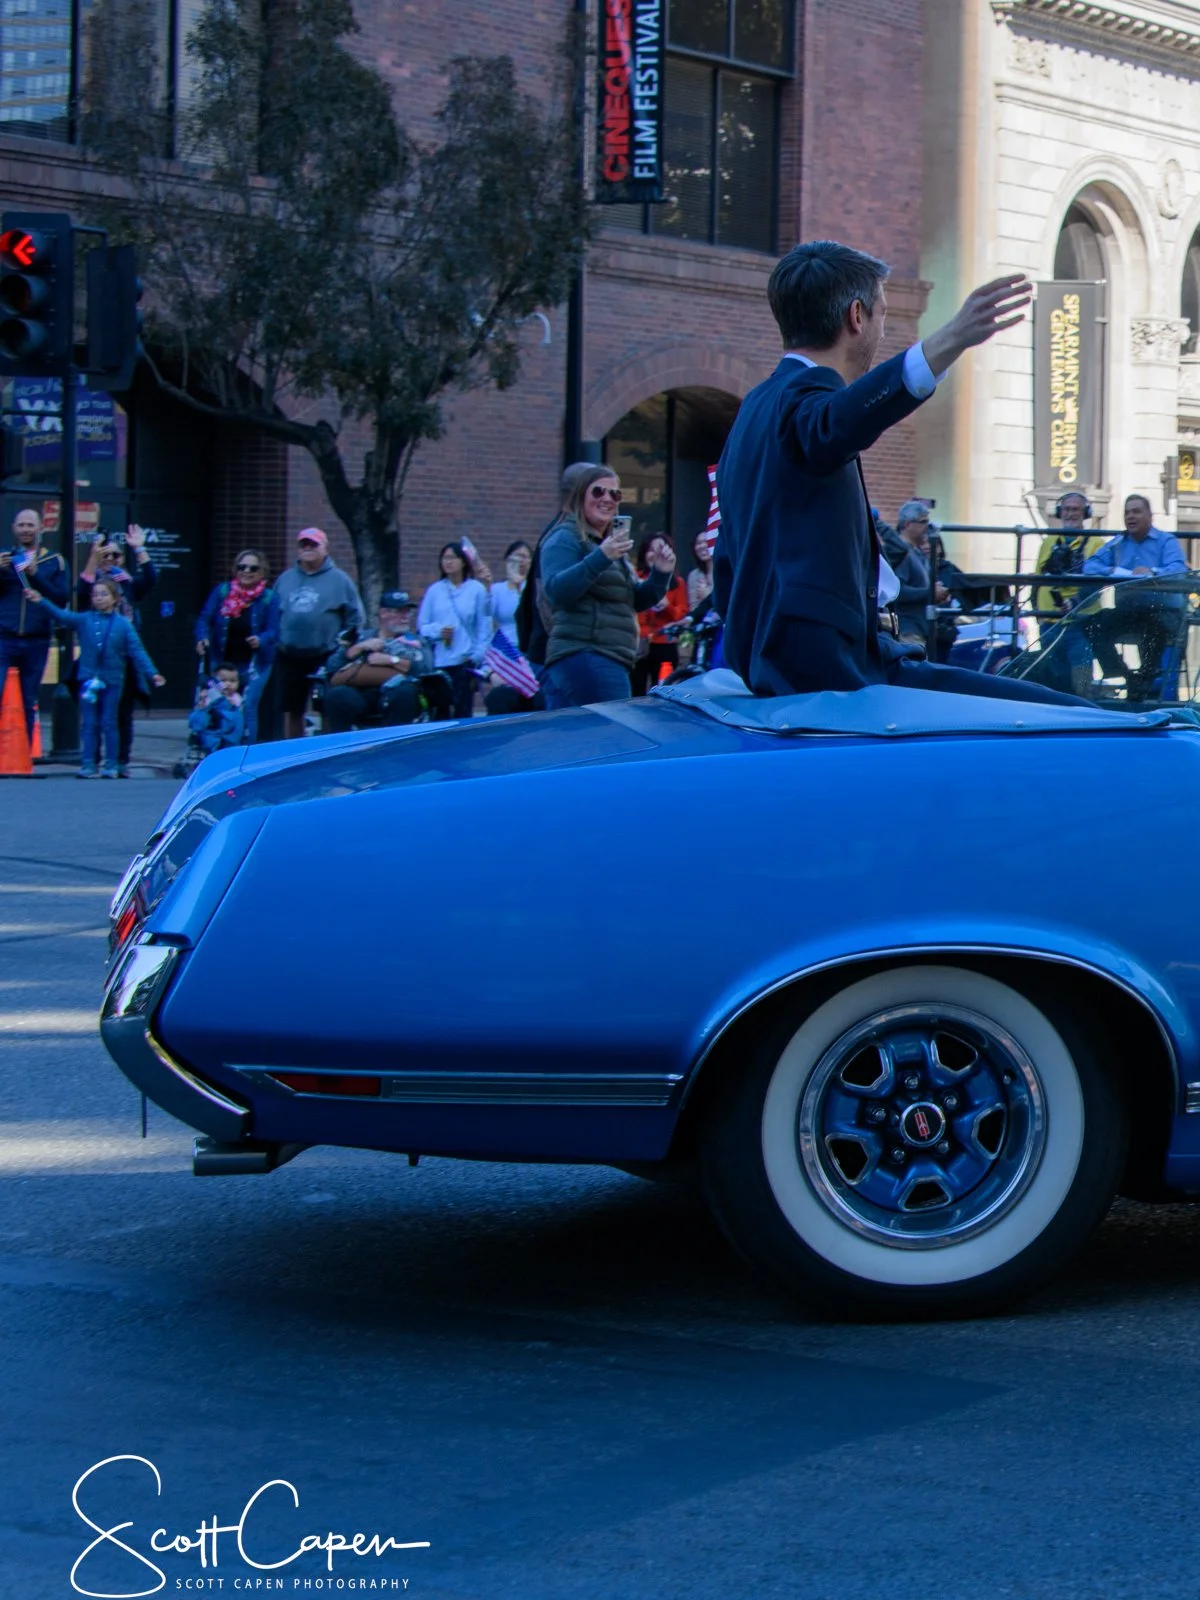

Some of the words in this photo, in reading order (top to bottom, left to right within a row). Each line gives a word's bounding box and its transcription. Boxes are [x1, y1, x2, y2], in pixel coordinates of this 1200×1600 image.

[634, 0, 660, 110] FESTIVAL
[634, 120, 657, 178] FILM
[1063, 294, 1080, 395] SPEARMINT
[1051, 421, 1064, 467] CLUBS
[1059, 423, 1077, 484] RHINO
